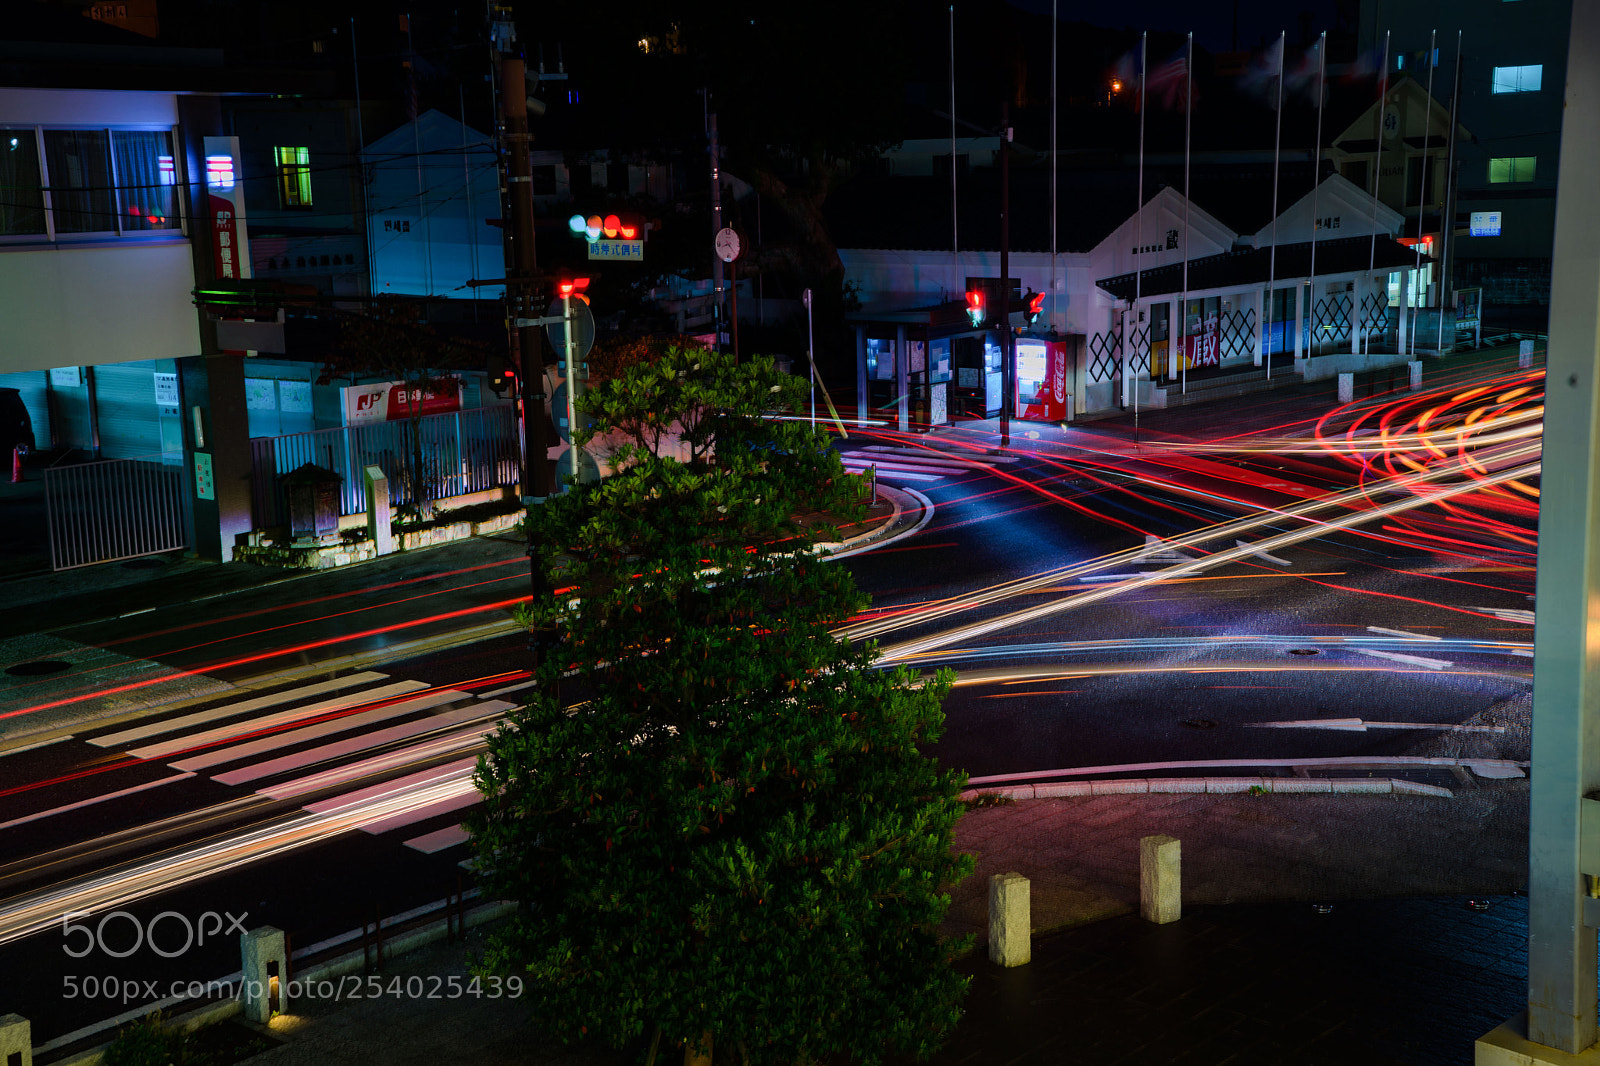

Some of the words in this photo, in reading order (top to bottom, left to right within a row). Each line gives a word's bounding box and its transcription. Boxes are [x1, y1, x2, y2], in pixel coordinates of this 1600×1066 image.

[219, 231, 233, 278] 郵便局
[590, 242, 641, 256] 時差式信号
[1055, 349, 1065, 404] Coca-Cola
